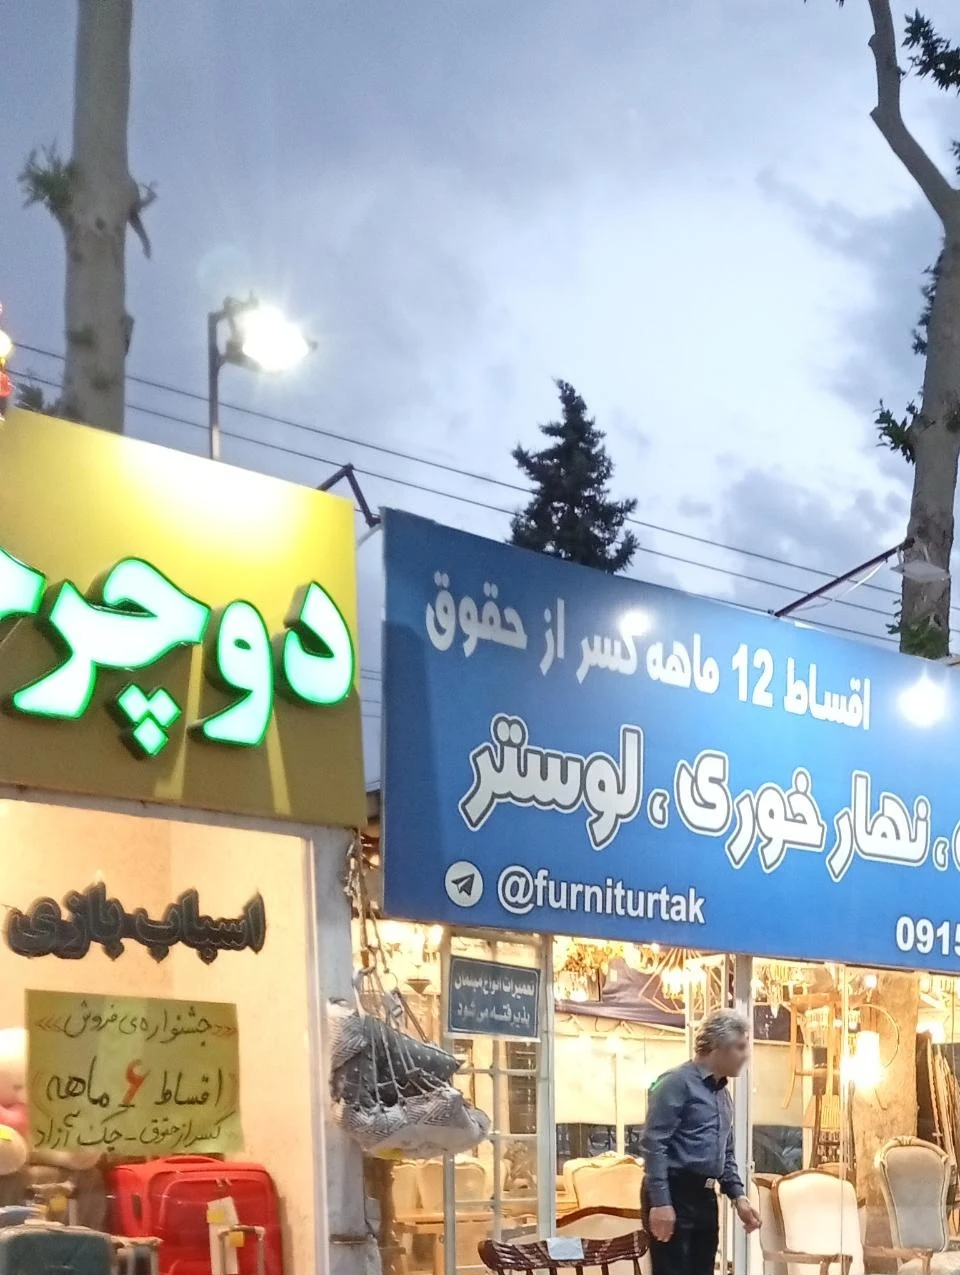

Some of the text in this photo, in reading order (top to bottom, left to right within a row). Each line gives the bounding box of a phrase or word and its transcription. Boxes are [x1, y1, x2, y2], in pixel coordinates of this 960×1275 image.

[0, 546, 355, 756] دوچر
[425, 571, 870, 730] اقساط 12 ماهه کسر از حقوق
[458, 712, 644, 850] لوستر
[4, 881, 266, 965] اسباب بازی
[497, 865, 706, 925] @furniturtak
[63, 999, 117, 1039] فروش
[46, 1055, 110, 1107] ماهه
[154, 1068, 223, 1106] اقساط
[139, 1118, 180, 1145] حقوق
[184, 1110, 236, 1148] کسر
